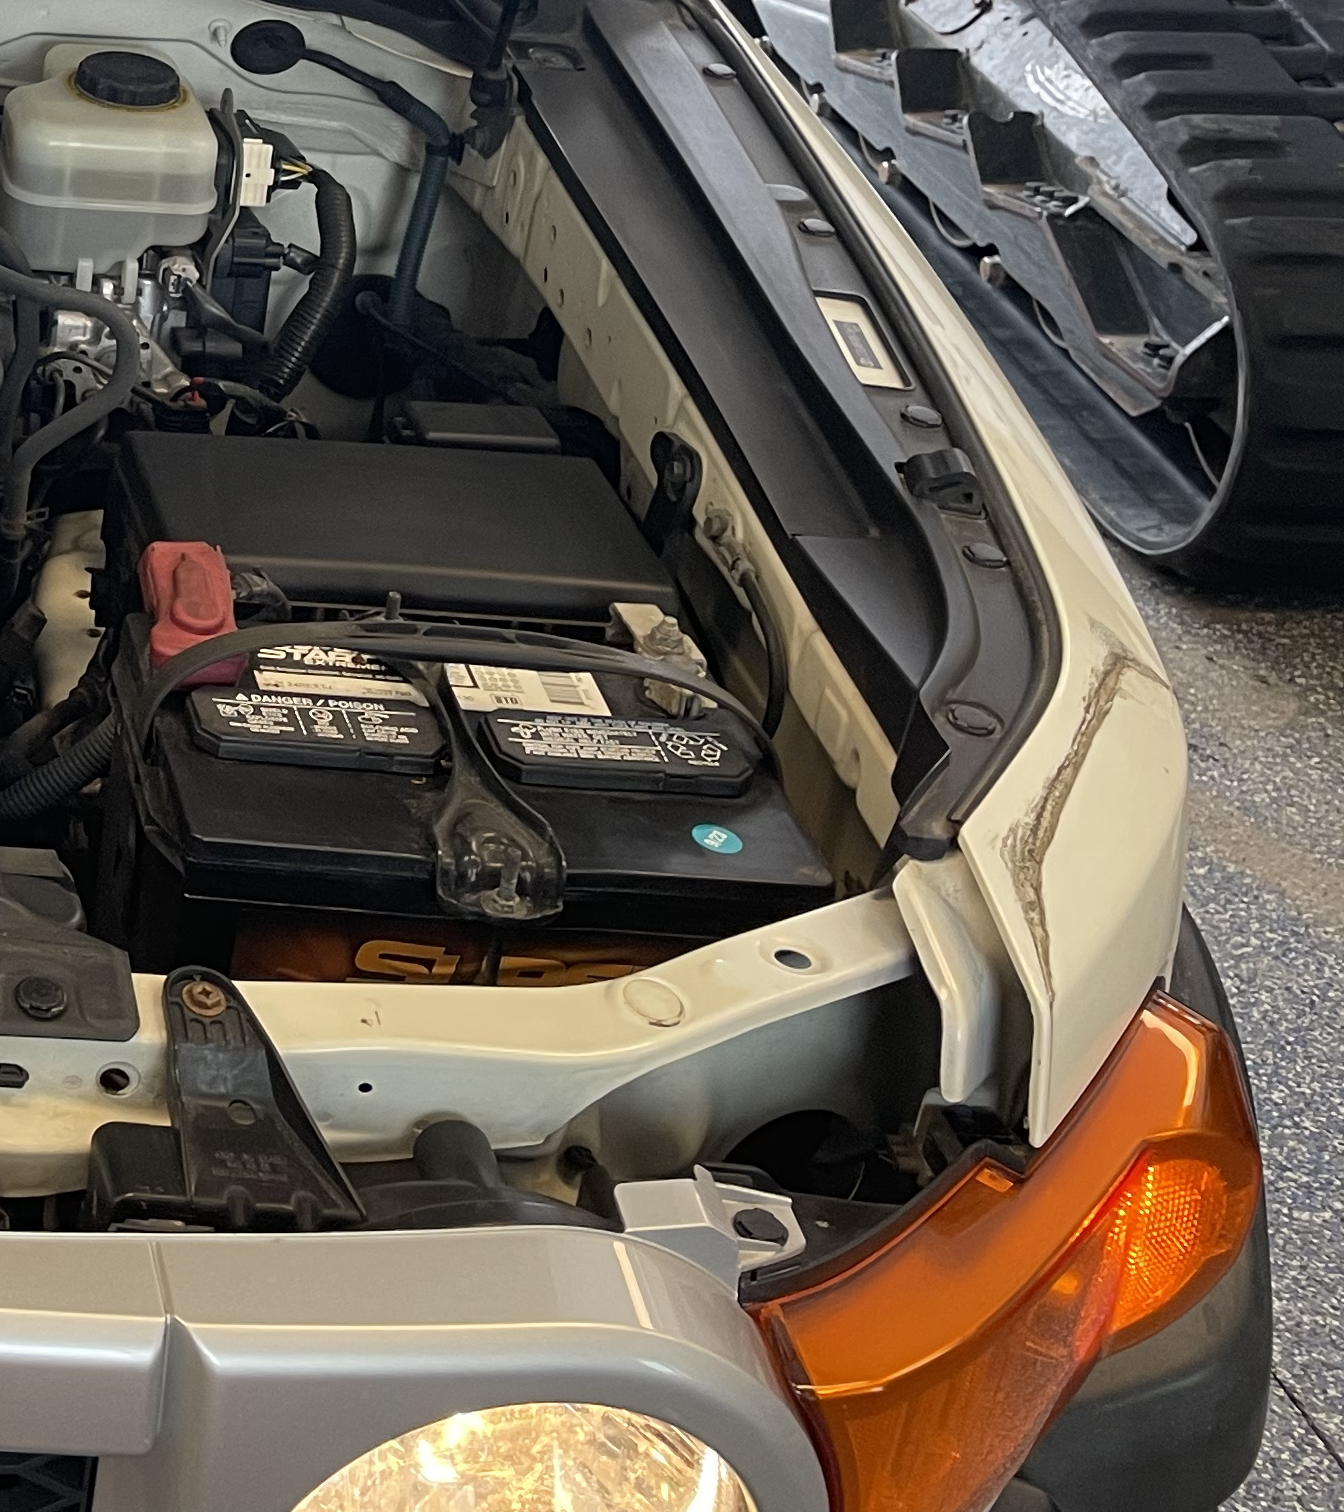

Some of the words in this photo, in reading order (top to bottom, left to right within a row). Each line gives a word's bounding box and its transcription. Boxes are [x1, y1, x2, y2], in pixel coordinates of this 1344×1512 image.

[250, 694, 313, 707] DANGER
[316, 699, 325, 707] /
[328, 699, 385, 711] POISON
